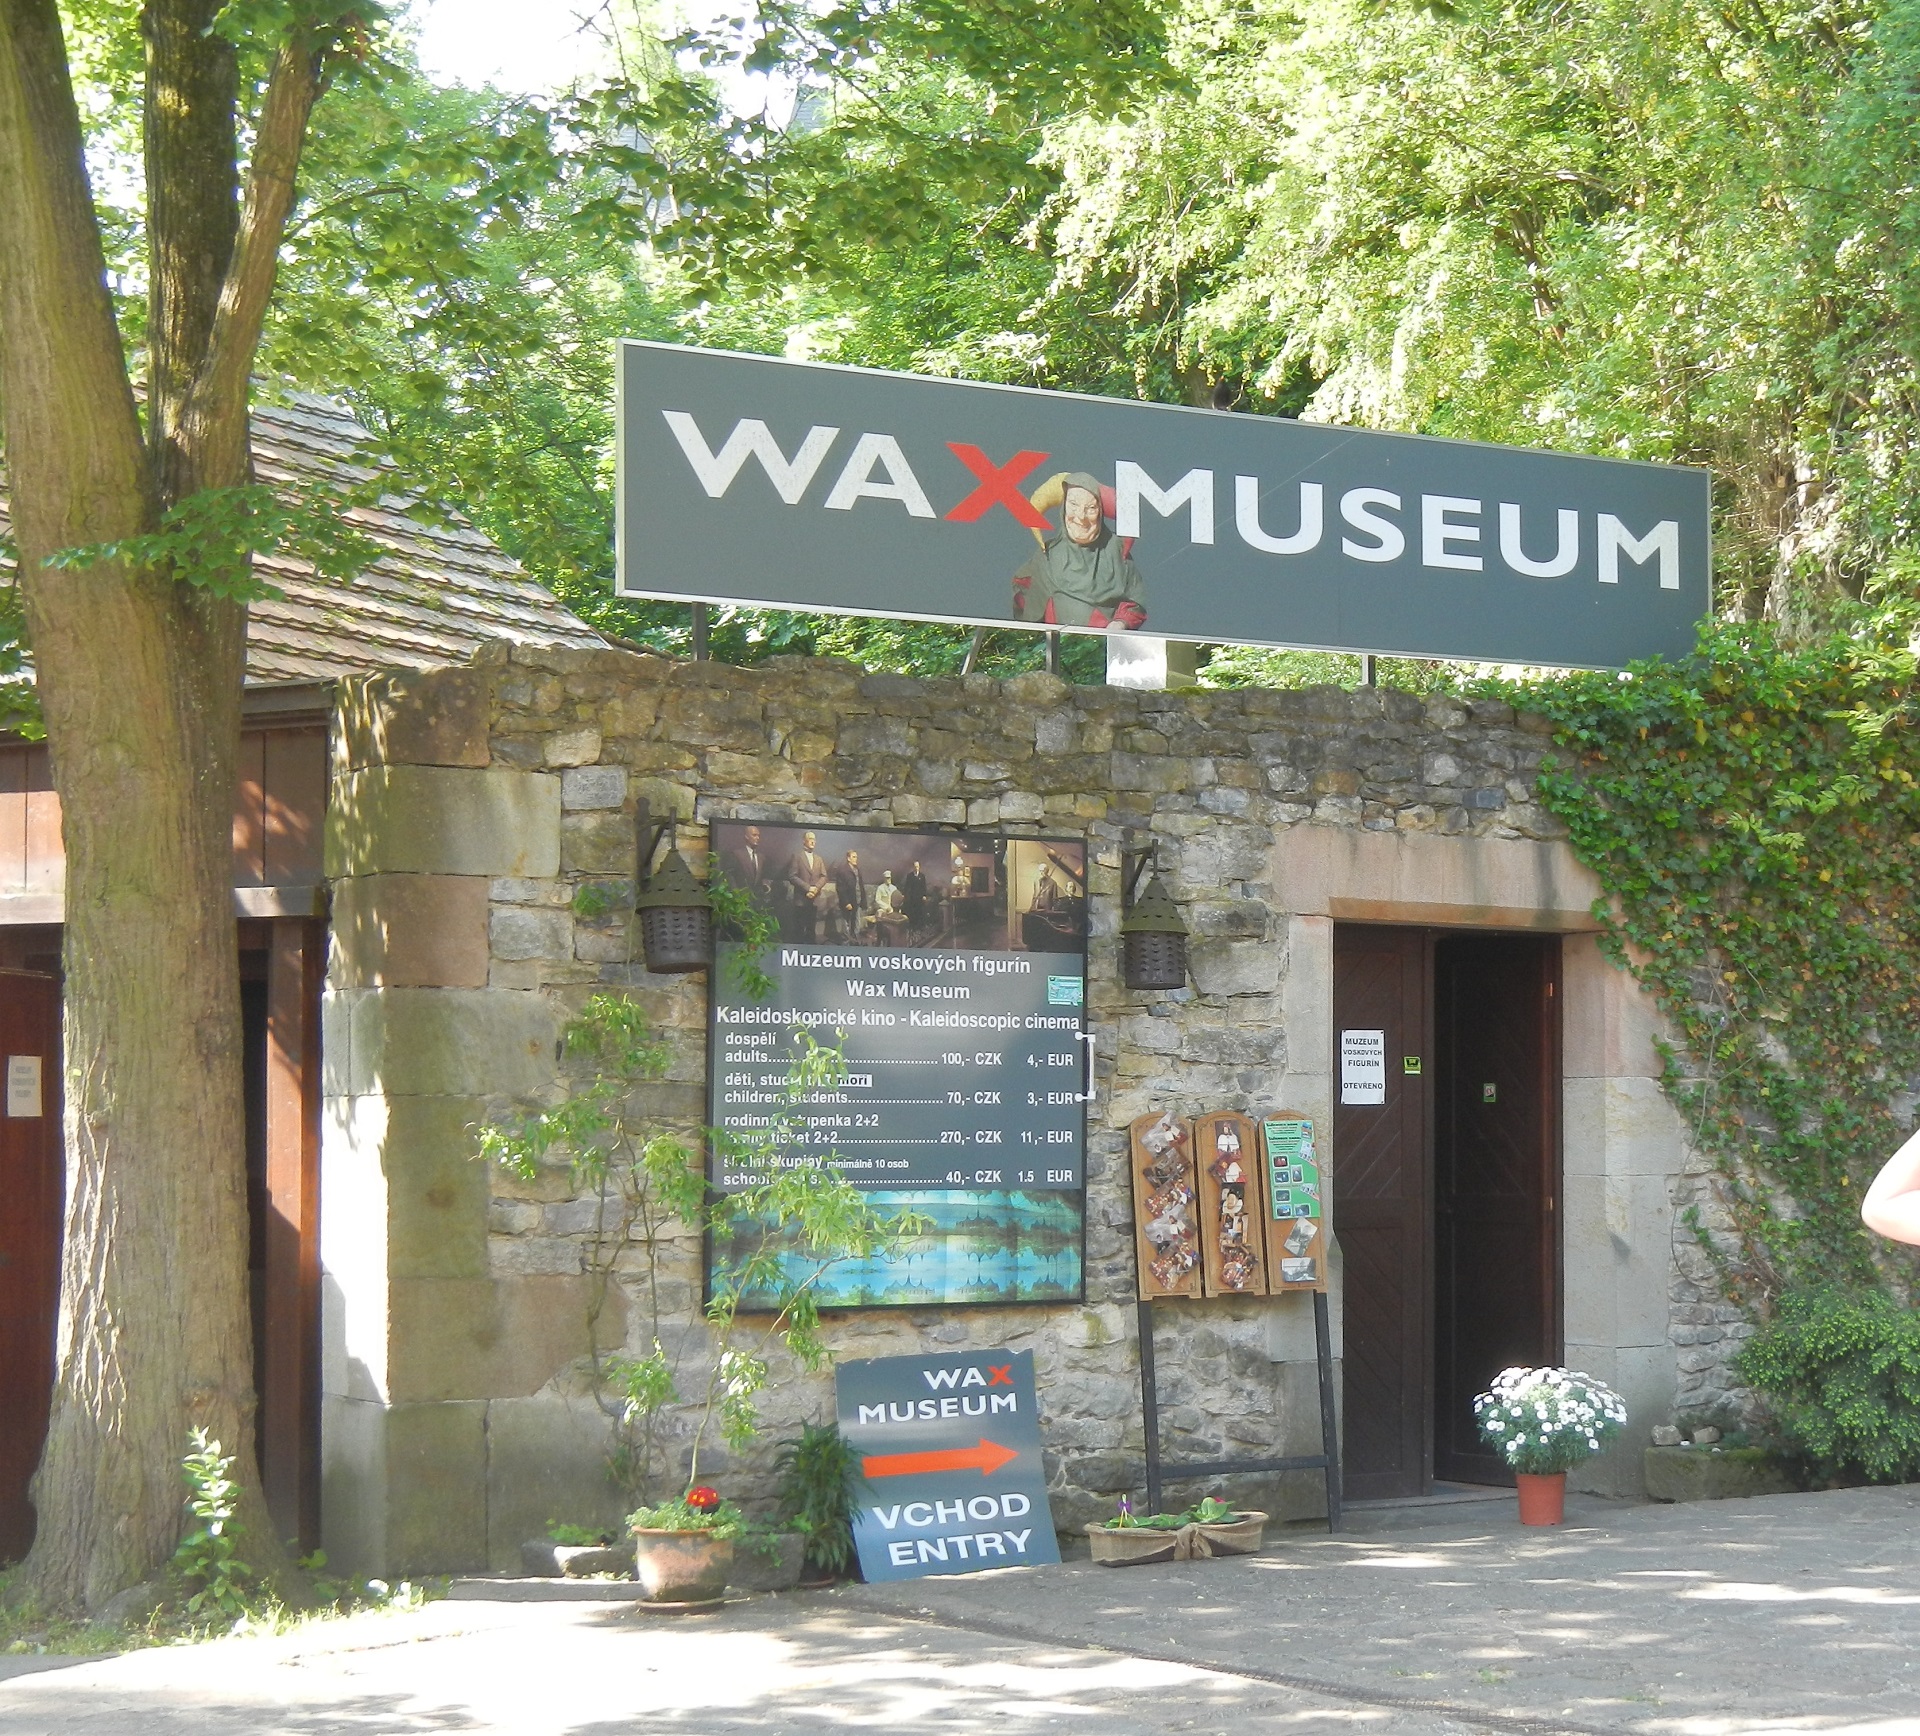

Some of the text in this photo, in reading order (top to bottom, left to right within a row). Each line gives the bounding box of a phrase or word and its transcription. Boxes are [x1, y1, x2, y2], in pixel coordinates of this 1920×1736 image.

[662, 410, 1680, 590] WAX MUSEUM
[781, 950, 1031, 976] Muzeum voskových figurín
[846, 979, 970, 999] Wax Museum
[716, 1006, 857, 1028] Kaleidoskopické
[861, 1009, 896, 1026] kino
[910, 1010, 1021, 1031] Kaleidoscopic
[1025, 1012, 1080, 1030] cinema
[725, 1032, 777, 1047] dospělí
[941, 1053, 970, 1066] 100,-
[975, 1053, 1002, 1066] CZK
[1027, 1054, 1044, 1067] 4,-
[1047, 1054, 1074, 1066] EUR
[725, 1072, 756, 1088] děti,
[1343, 1081, 1383, 1089] OTEVŘENO
[724, 1090, 785, 1106] children,
[947, 1092, 971, 1106] 70,-
[974, 1092, 1001, 1104] CZK
[1027, 1092, 1044, 1106] 3,-
[1047, 1093, 1074, 1105] EUR
[855, 1114, 879, 1127] 2+2
[940, 1131, 970, 1145] 270,-
[975, 1131, 1002, 1143] CZK
[1047, 1131, 1073, 1143] EUR
[827, 1158, 872, 1169] minimálně
[875, 1159, 885, 1168] 10
[888, 1159, 909, 1168] osob
[946, 1171, 970, 1185] 40,-
[975, 1171, 1002, 1183] CZK
[1018, 1170, 1034, 1183] 1.5
[1047, 1170, 1073, 1183] EUR
[922, 1364, 1014, 1391] WAX
[858, 1392, 1018, 1425] MUSEUM
[871, 1493, 1032, 1531] VCHOD
[887, 1528, 1033, 1567] ENTRY
